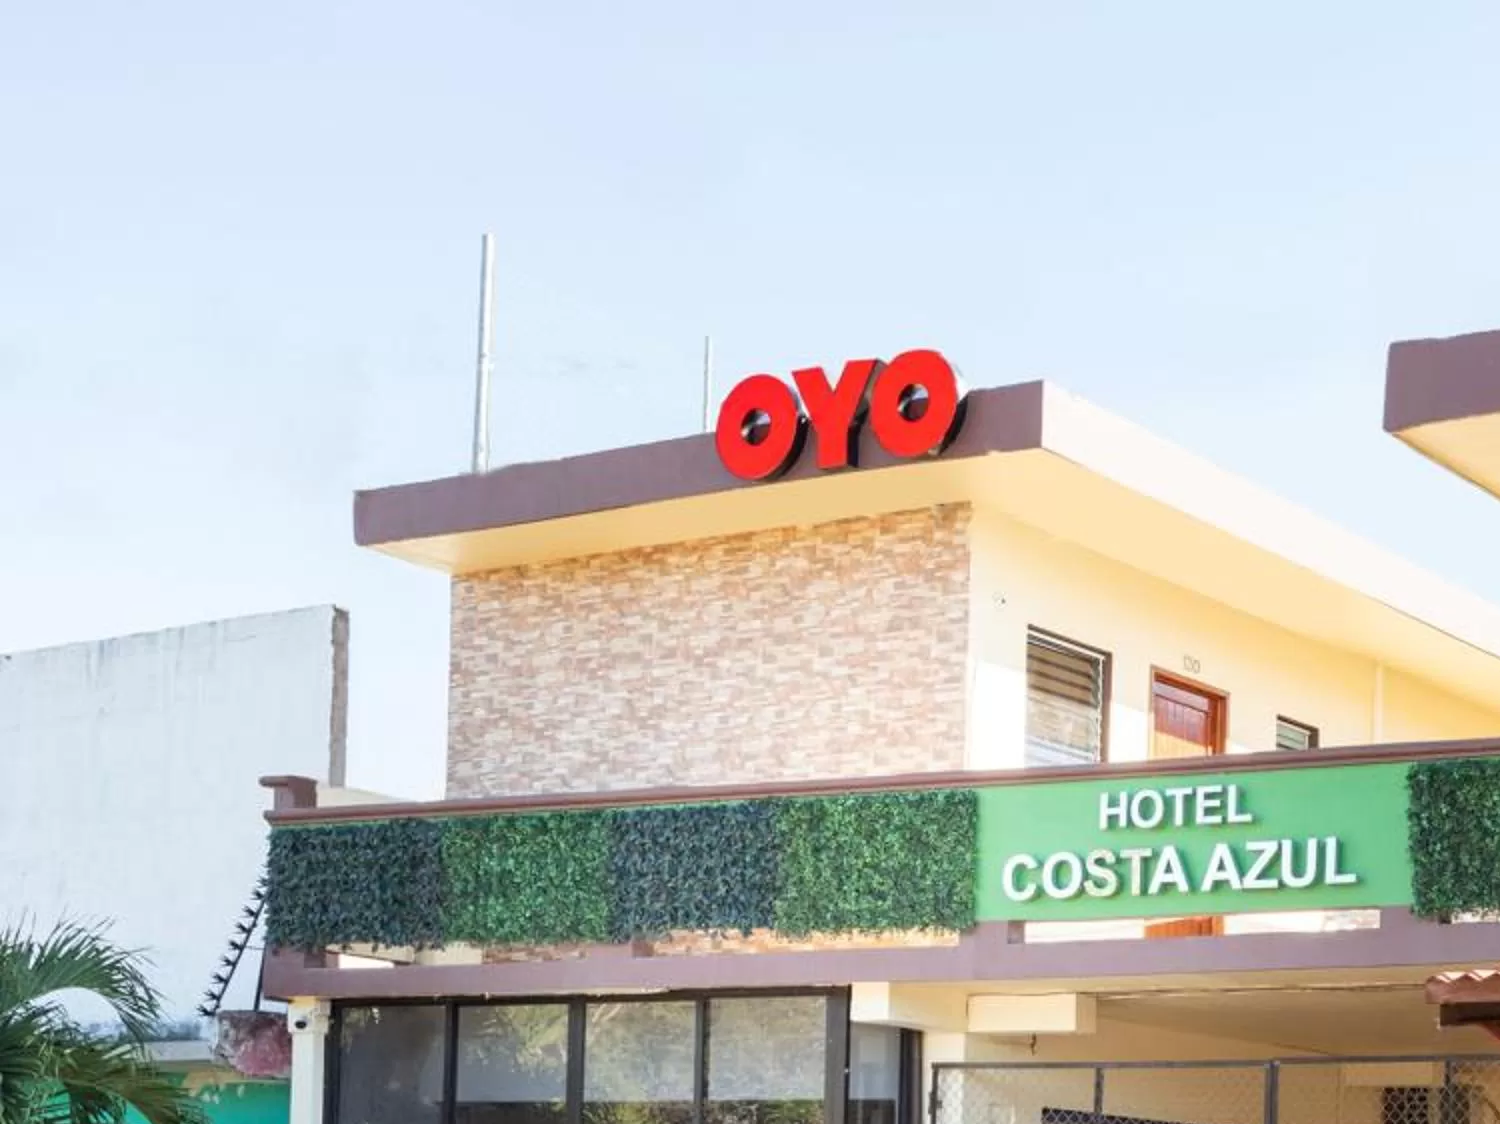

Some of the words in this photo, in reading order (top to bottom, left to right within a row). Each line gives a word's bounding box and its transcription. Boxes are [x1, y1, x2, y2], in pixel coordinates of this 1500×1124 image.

[715, 348, 960, 481] OYO
[1098, 784, 1253, 831] HOTEL
[1002, 845, 1189, 901] COSTA
[1201, 836, 1358, 891] AZUL
